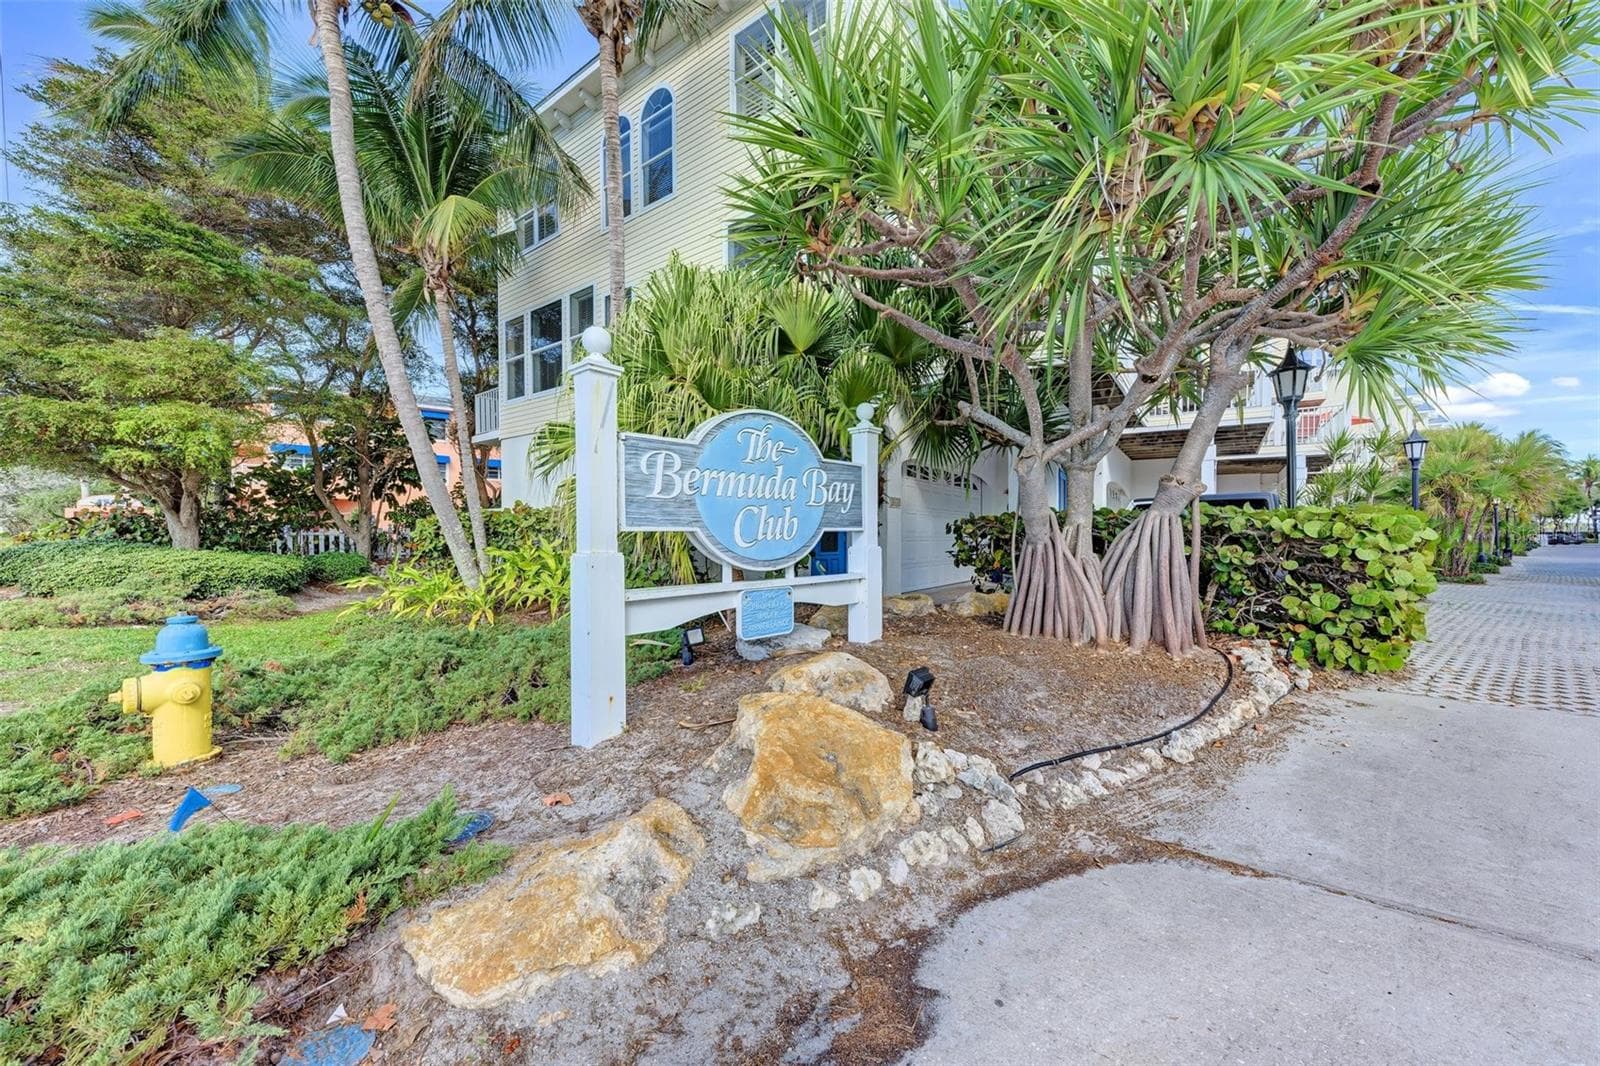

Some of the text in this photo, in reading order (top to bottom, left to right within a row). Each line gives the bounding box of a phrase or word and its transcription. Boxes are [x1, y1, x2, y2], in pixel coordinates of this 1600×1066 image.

[737, 424, 798, 463] The
[641, 450, 855, 513] Bermuda Bay
[734, 505, 798, 548] Club
